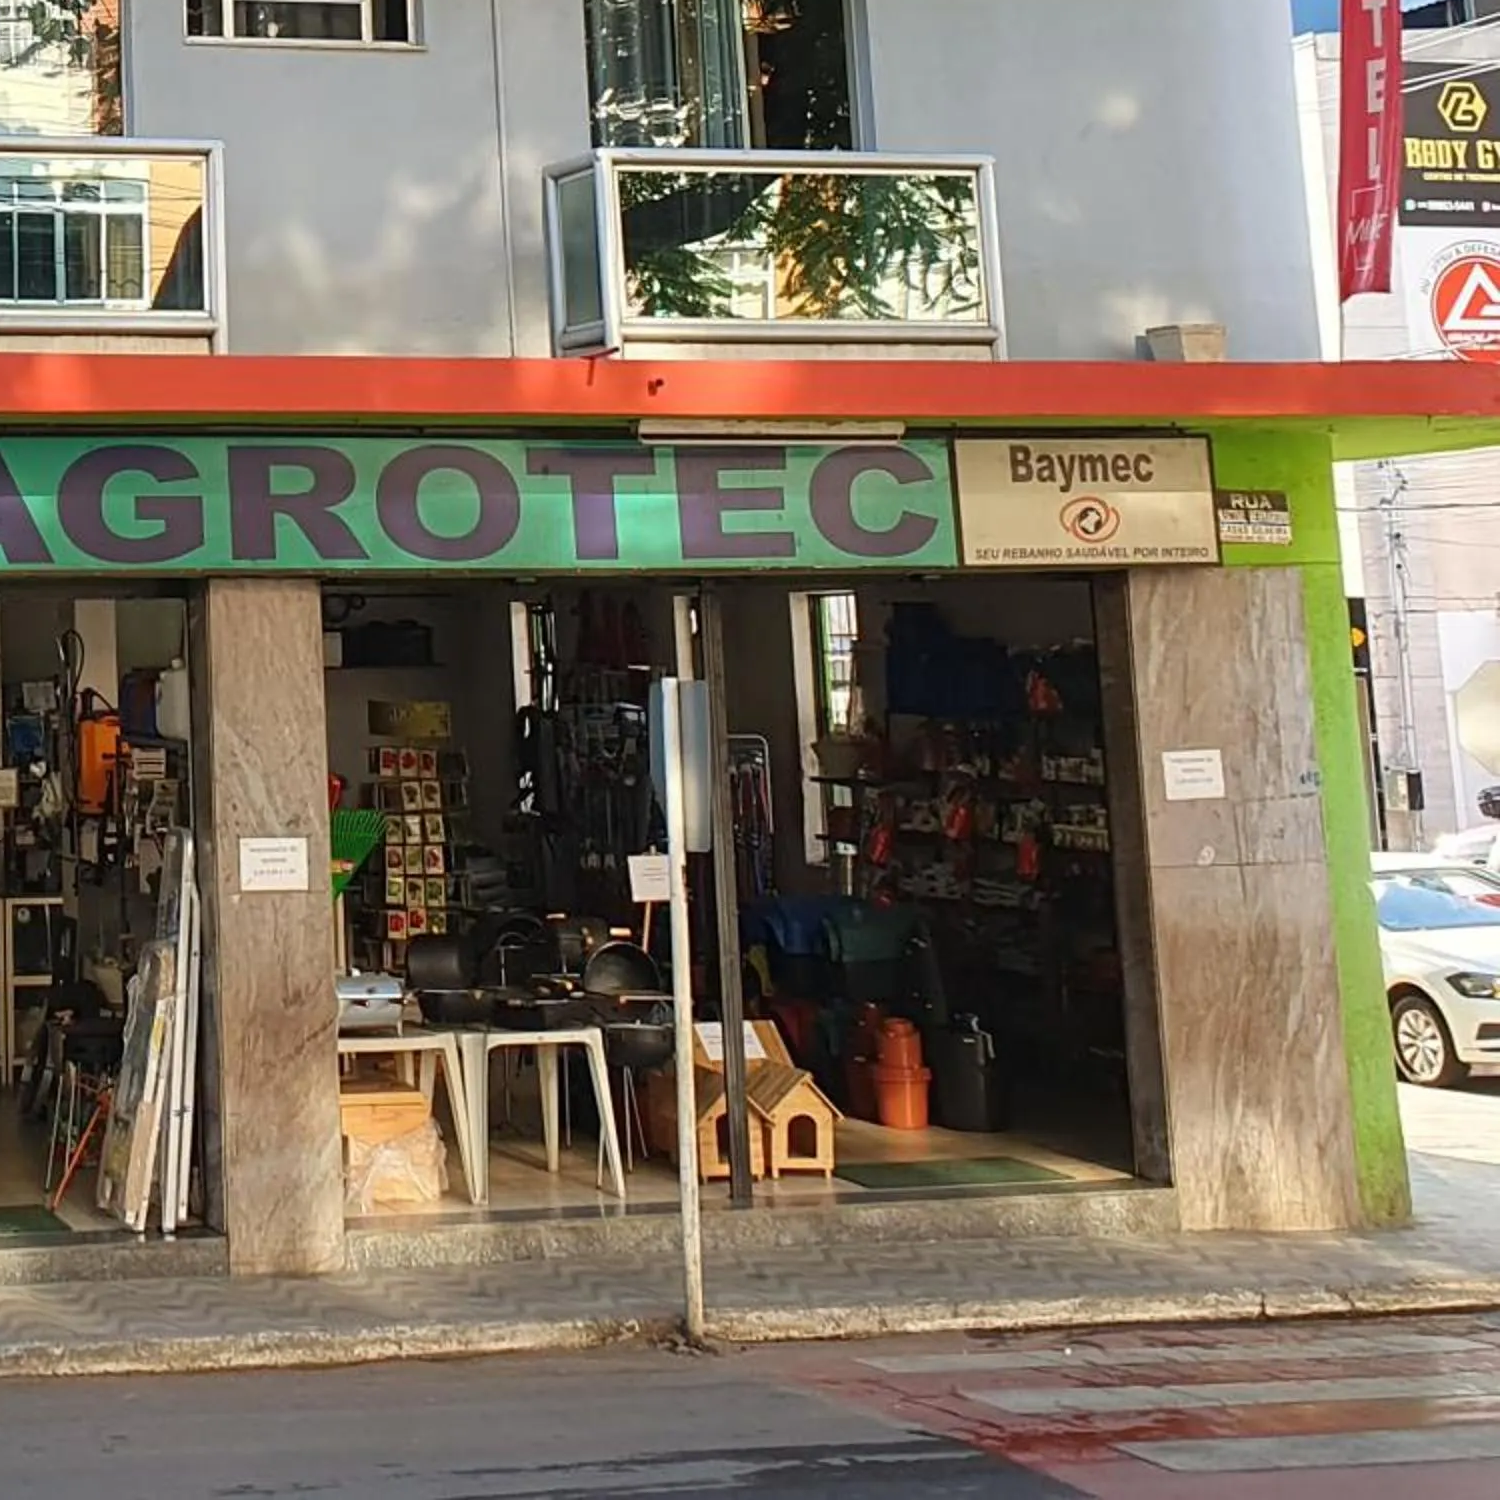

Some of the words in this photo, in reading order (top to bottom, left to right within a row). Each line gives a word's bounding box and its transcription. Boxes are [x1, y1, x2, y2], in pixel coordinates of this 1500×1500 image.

[1403, 137, 1468, 169] BODY
[1008, 444, 1155, 493] Baymec
[1229, 492, 1273, 509] RUA
[975, 547, 1000, 560] SEU
[1002, 547, 1063, 560] REBANHO
[1066, 545, 1130, 560] SAUDÁVEL
[1133, 547, 1159, 559] POR
[1161, 546, 1209, 559] INTEIRO
